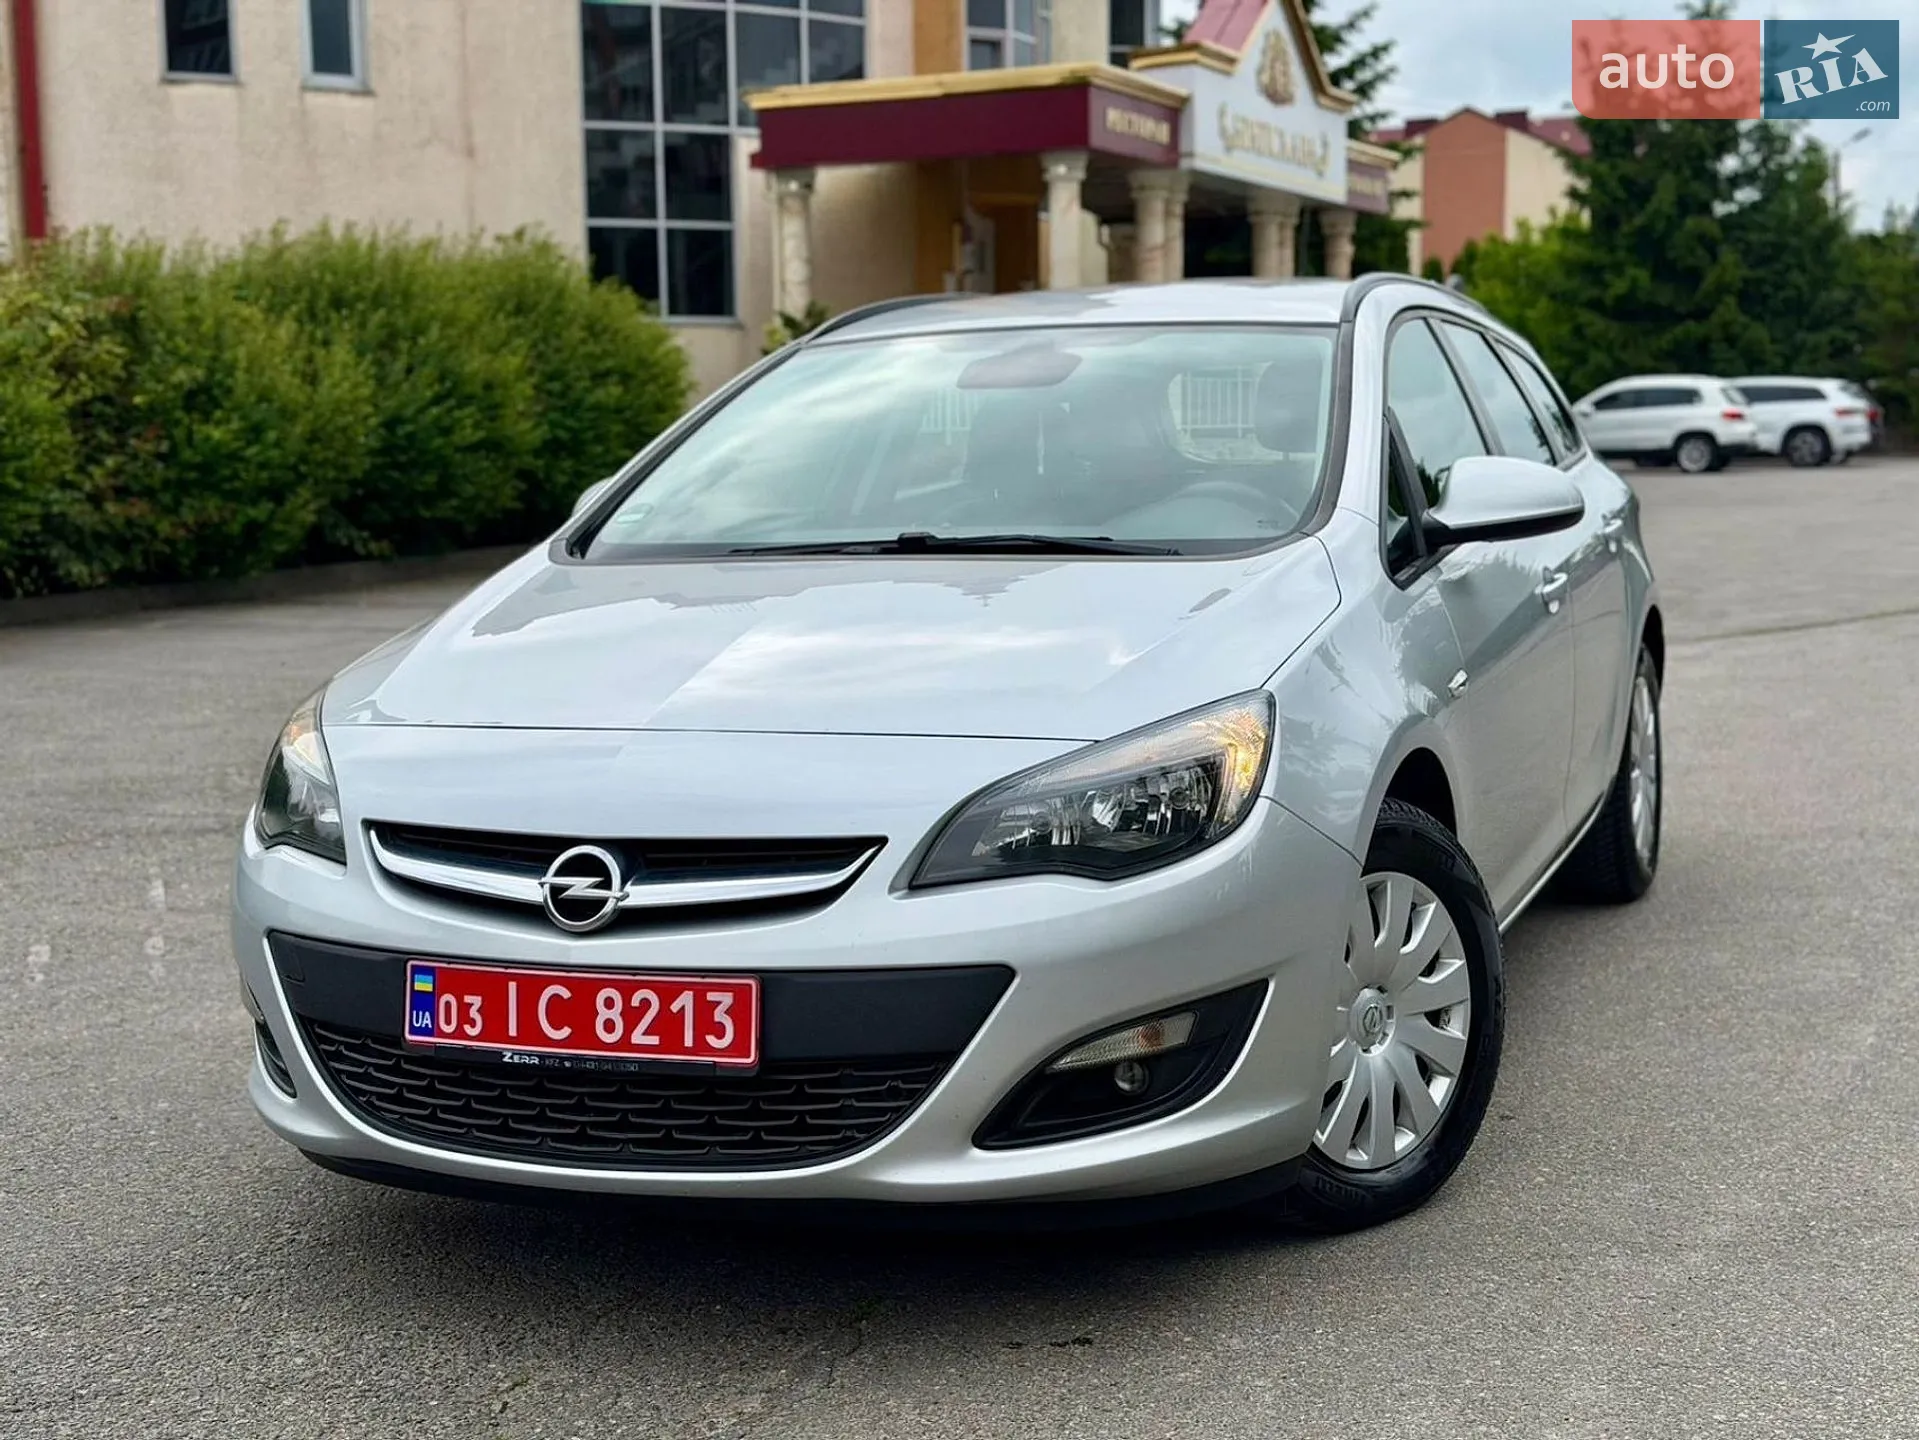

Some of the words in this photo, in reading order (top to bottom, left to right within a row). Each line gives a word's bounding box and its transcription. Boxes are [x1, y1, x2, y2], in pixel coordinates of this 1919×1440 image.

[412, 1010, 433, 1029] UA
[438, 993, 483, 1037] 03
[507, 981, 573, 1041] IC
[595, 987, 735, 1050] 8213
